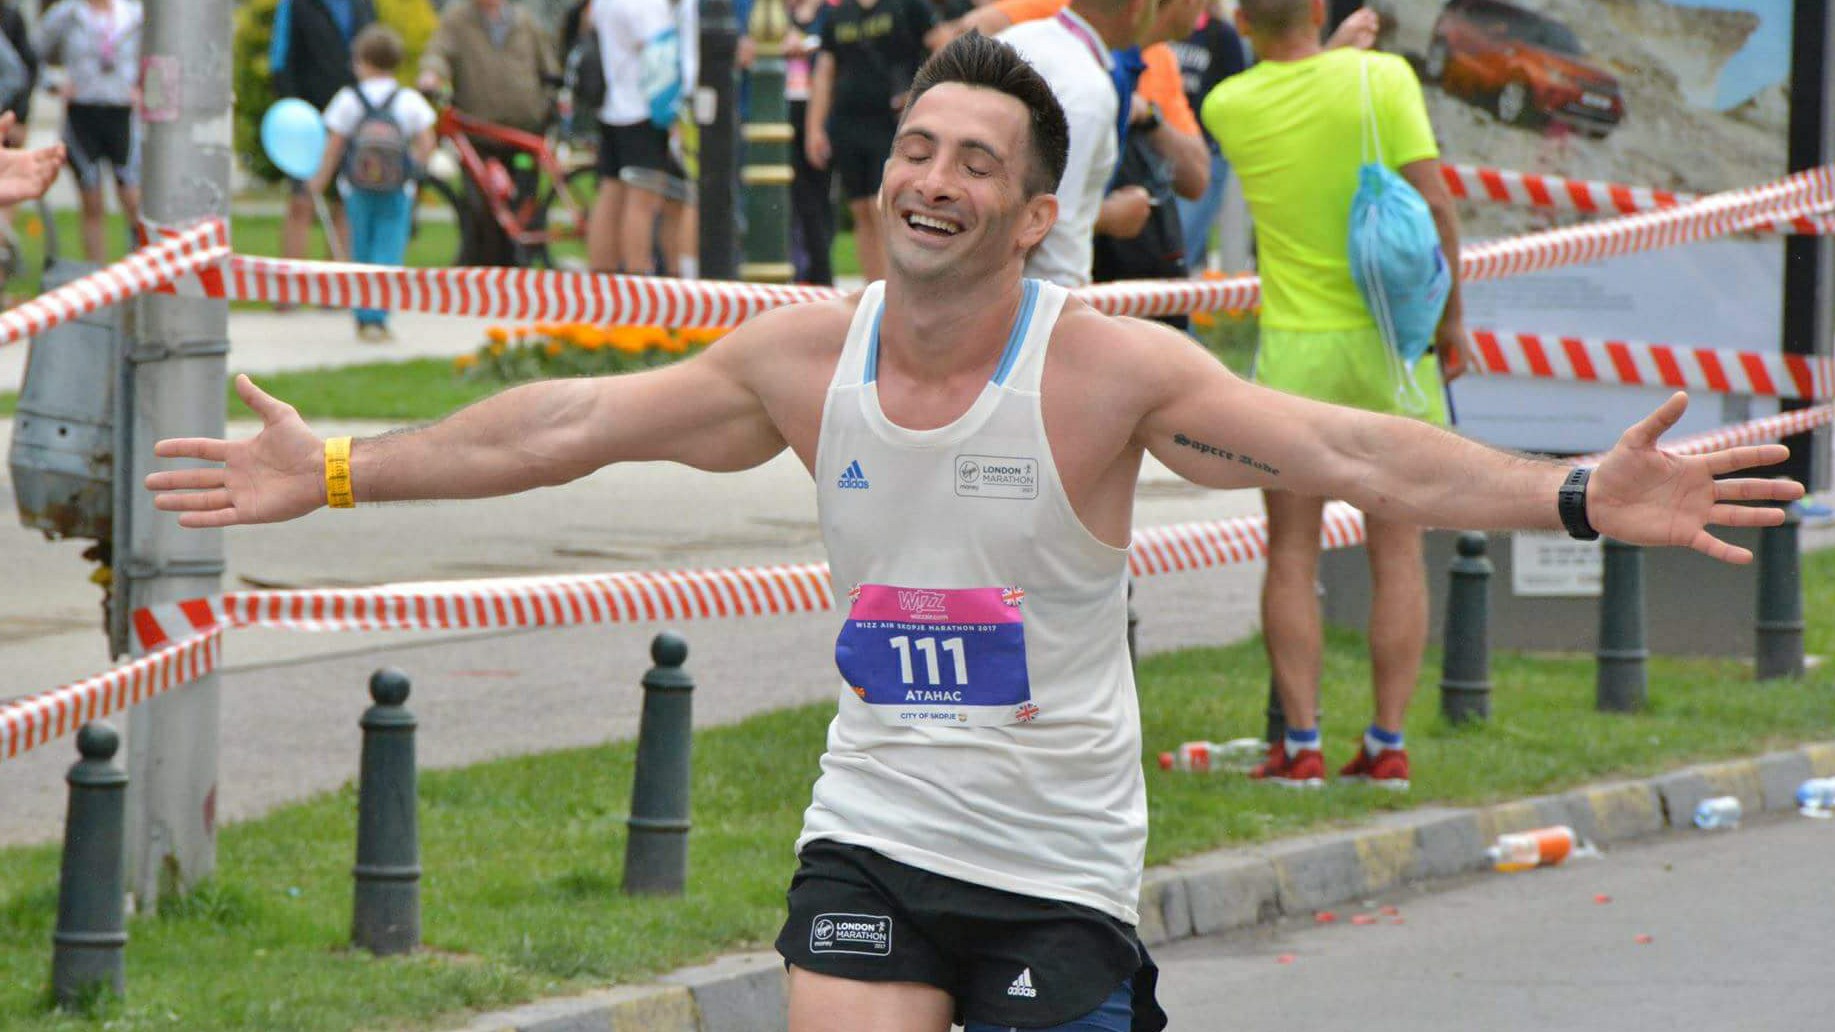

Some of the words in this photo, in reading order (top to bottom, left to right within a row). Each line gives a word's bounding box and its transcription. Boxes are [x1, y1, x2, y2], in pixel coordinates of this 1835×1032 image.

[983, 466, 1021, 475] LONDON
[838, 478, 870, 489] adidas
[983, 474, 1034, 484] MARATHON
[897, 623, 925, 631] SKOPJE
[928, 624, 975, 632] MARATHON
[889, 635, 968, 685] 111
[900, 712, 917, 720] CITY
[918, 712, 929, 720] OF
[930, 712, 957, 720] SKOPJE
[836, 922, 875, 931] LONDON
[836, 930, 887, 940] MARATHON
[1007, 985, 1037, 998] adidas
